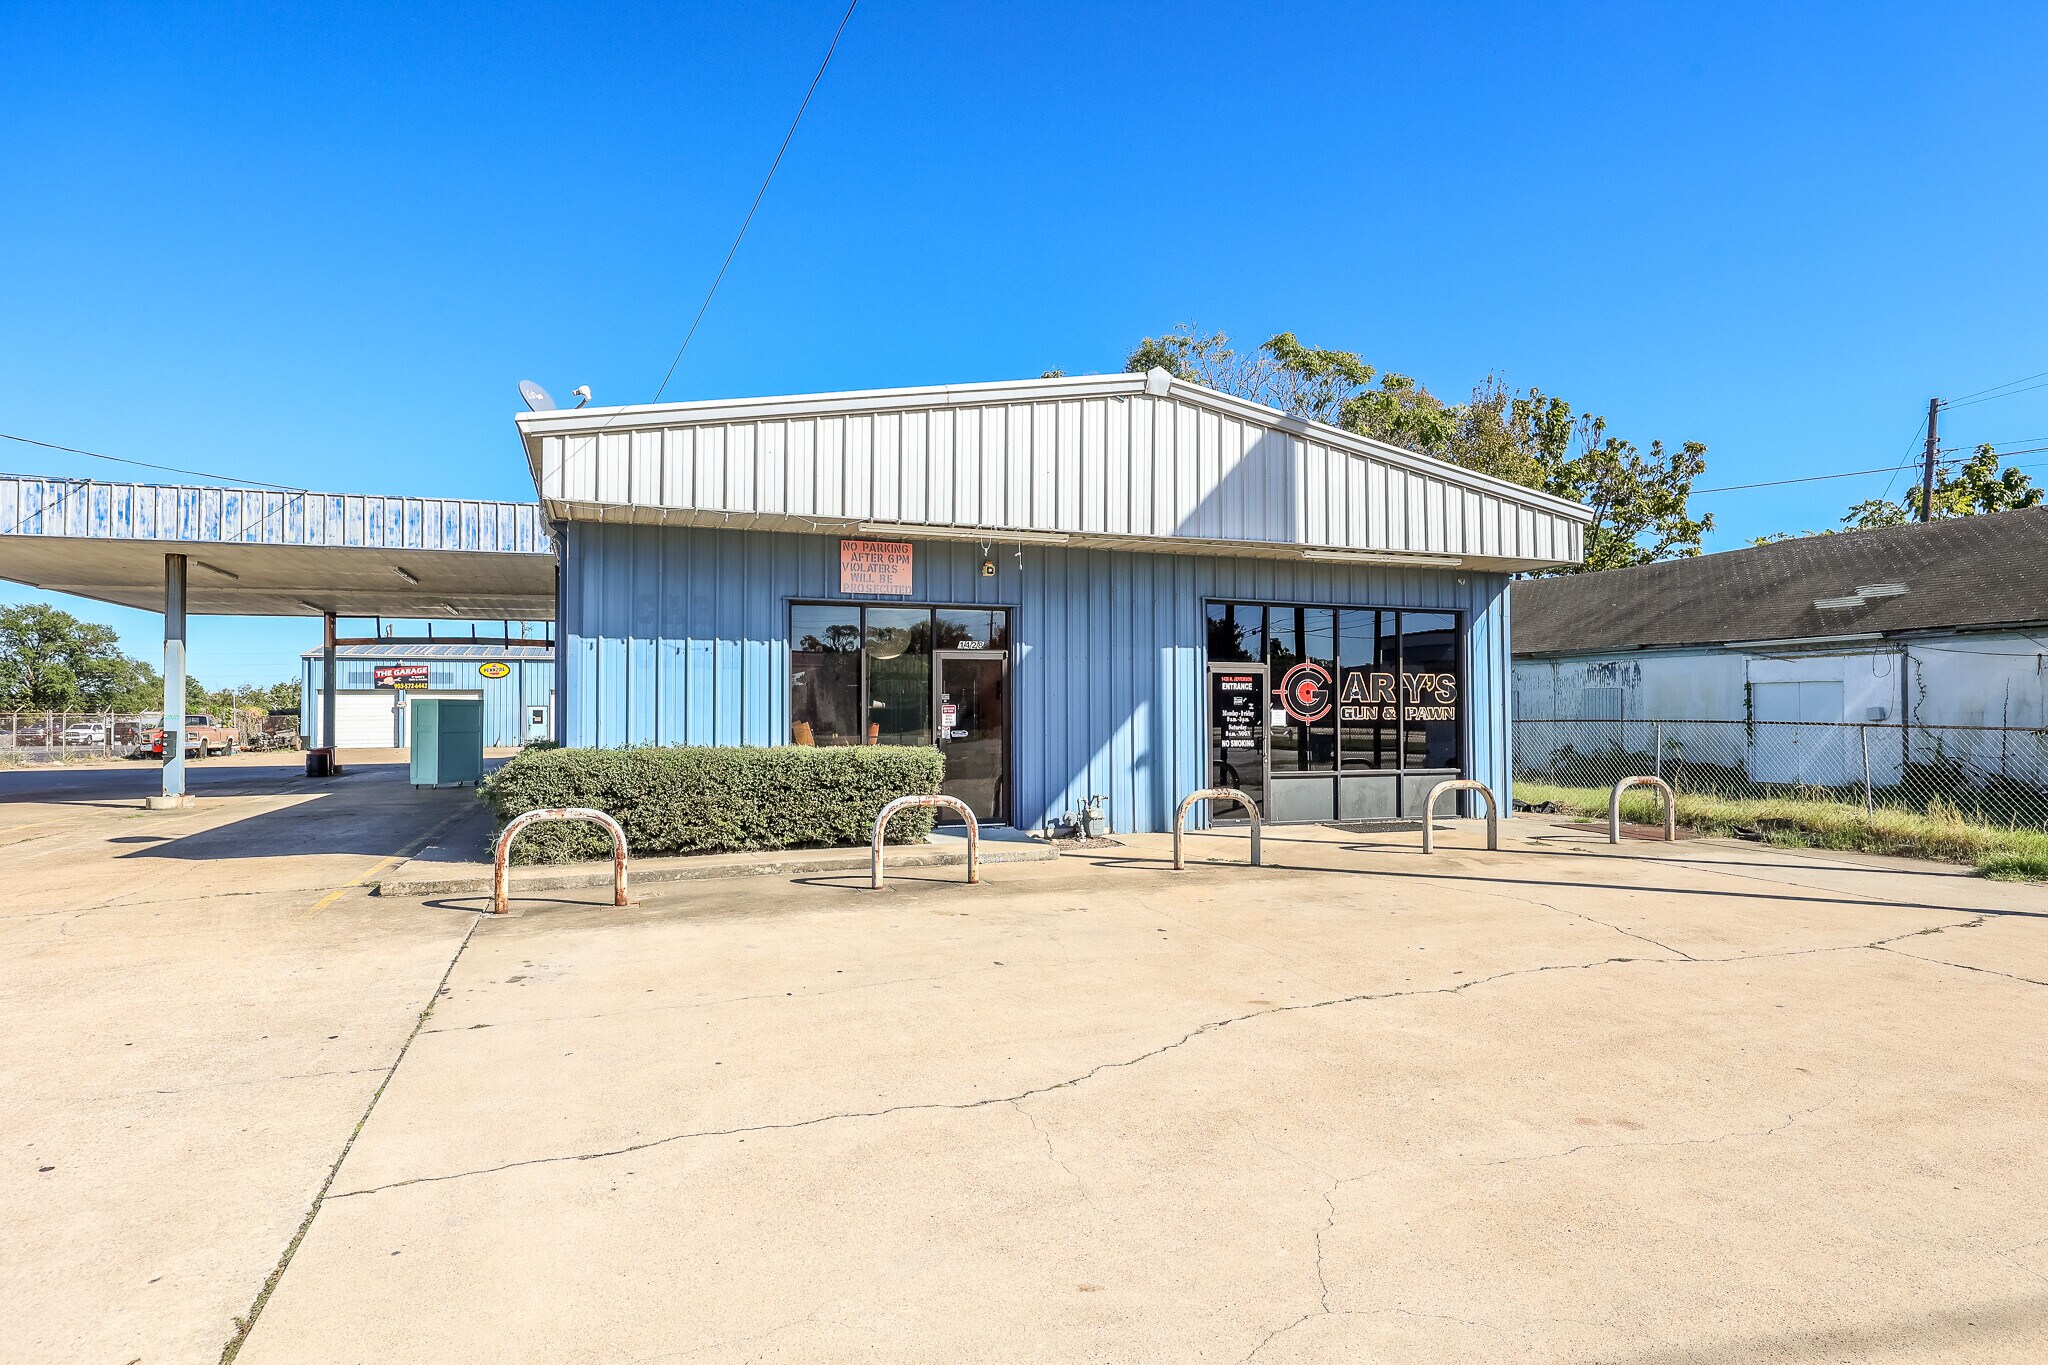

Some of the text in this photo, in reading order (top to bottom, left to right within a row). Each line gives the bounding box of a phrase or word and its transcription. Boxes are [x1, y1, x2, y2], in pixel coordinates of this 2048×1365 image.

[842, 542, 908, 554] NO PARKING
[850, 552, 884, 562] AFTER
[842, 562, 898, 573] VIOLATERS
[850, 573, 892, 584] WILL BE
[843, 583, 911, 594] PROSECUTED
[393, 667, 428, 676] GARAGE
[1222, 682, 1252, 690] ENTRANCE
[1340, 706, 1456, 721] GUN & PAWN
